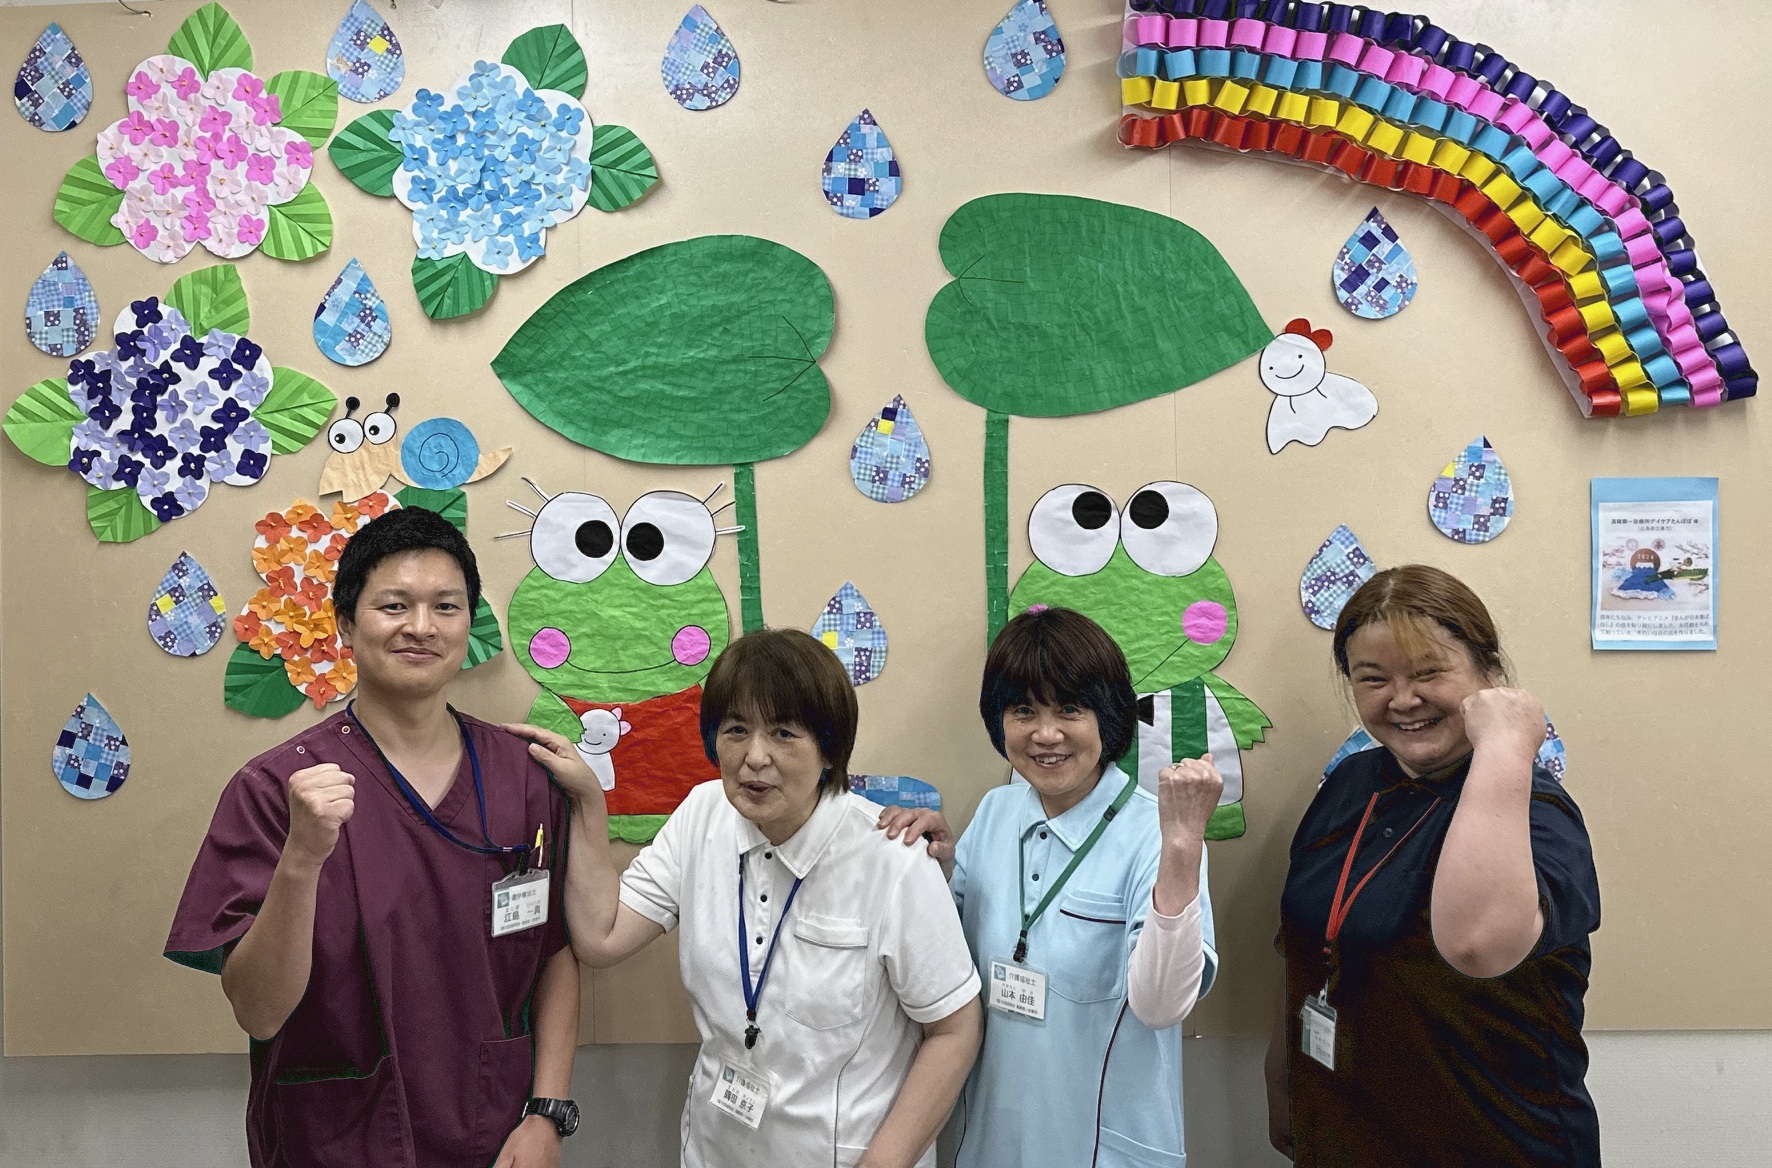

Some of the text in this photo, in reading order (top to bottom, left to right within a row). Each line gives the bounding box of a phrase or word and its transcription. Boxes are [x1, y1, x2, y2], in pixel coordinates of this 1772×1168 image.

[1009, 972, 1036, 986] 介護福祉士
[1001, 988, 1016, 1000] 山本
[1019, 993, 1035, 1006] 由佳
